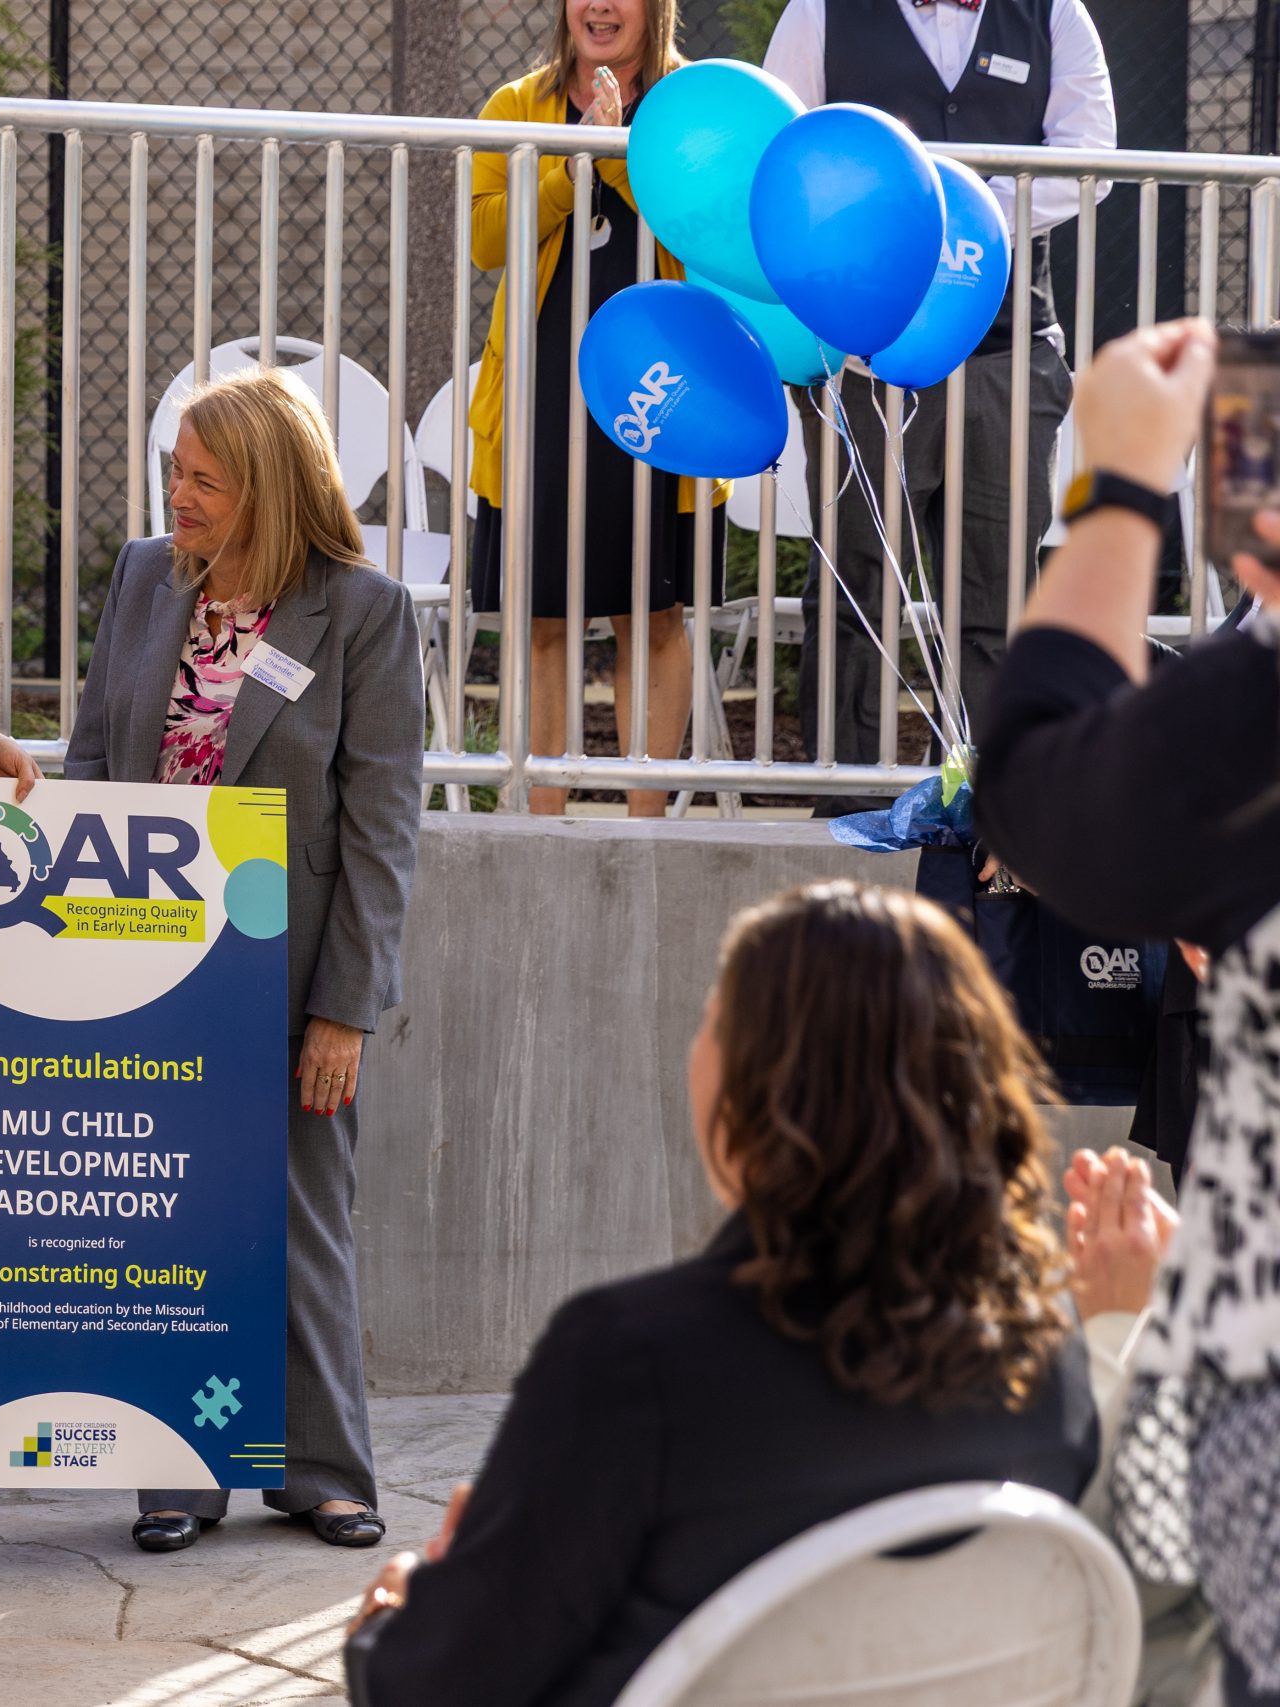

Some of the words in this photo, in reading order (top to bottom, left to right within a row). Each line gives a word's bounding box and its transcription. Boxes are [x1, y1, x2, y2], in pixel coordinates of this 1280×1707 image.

[939, 238, 983, 276] AR
[614, 361, 684, 454] QAR
[265, 658, 295, 678] Chandler
[268, 649, 302, 672] Stephanie
[253, 671, 288, 694] EDUCATION
[66, 903, 147, 920] Recognizing
[150, 906, 198, 921] Quality
[77, 919, 89, 931] in
[93, 920, 125, 935] Early
[129, 921, 187, 937] Learning
[1080, 945, 1141, 983] QAR
[2, 1109, 51, 1136] MU
[61, 1111, 154, 1138] CHILD
[28, 1236, 38, 1248] is
[41, 1237, 105, 1251] recognized
[108, 1237, 126, 1249] for
[125, 1264, 207, 1291] Quality
[54, 1302, 112, 1315] education
[116, 1303, 130, 1318] by
[133, 1304, 152, 1315] the
[155, 1304, 205, 1316] Missouri
[12, 1318, 79, 1333] Elementary
[81, 1319, 104, 1331] and
[107, 1319, 168, 1334] Secondary
[171, 1320, 229, 1332] Education
[54, 1429, 116, 1441] SUCCESS
[54, 1442, 72, 1454] AT
[74, 1442, 116, 1454] EVERY
[54, 1455, 97, 1467] STAGE
